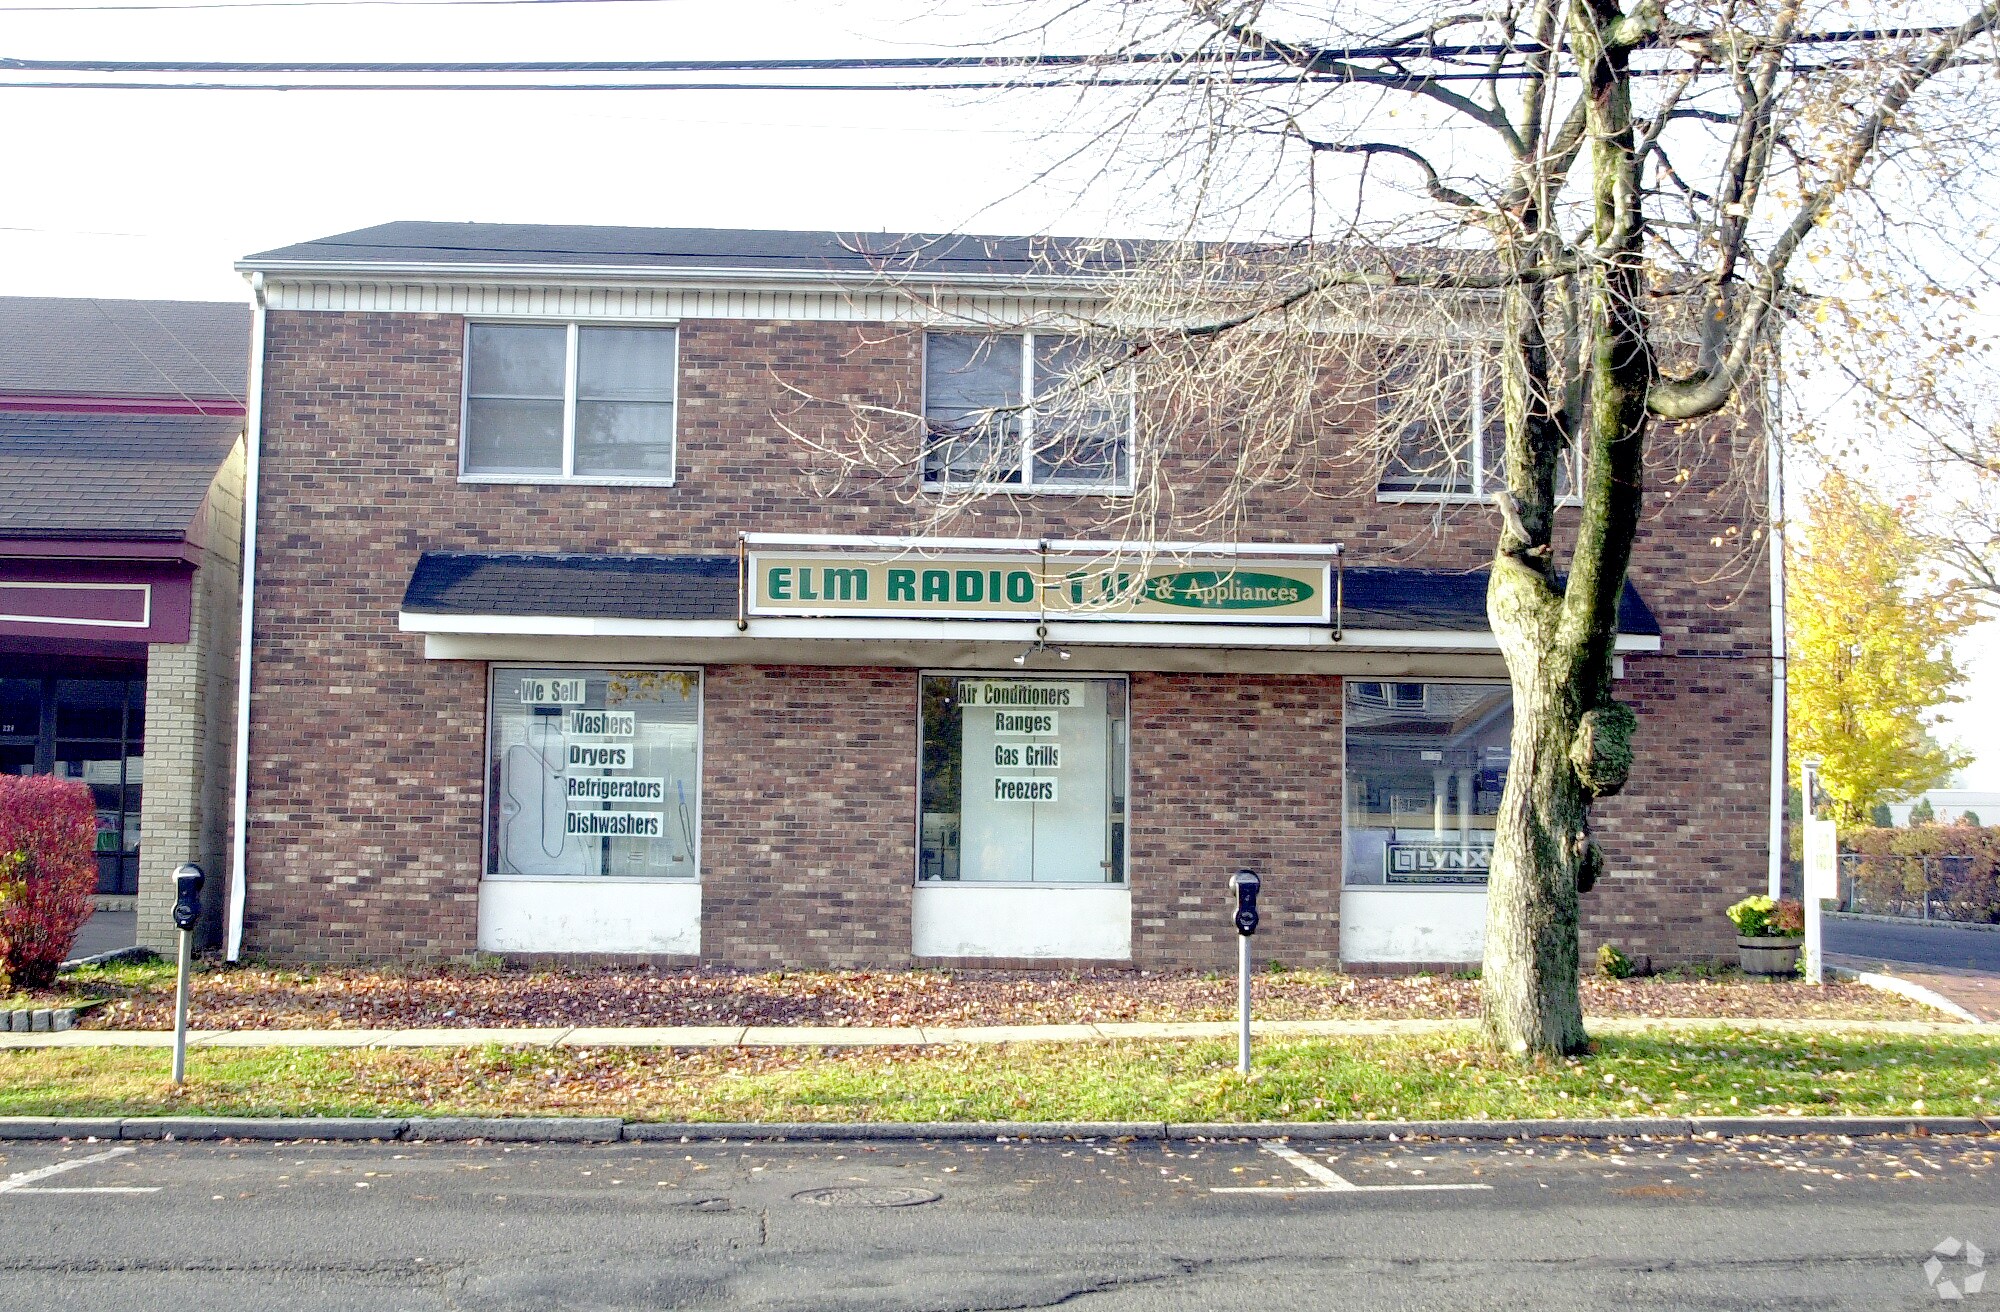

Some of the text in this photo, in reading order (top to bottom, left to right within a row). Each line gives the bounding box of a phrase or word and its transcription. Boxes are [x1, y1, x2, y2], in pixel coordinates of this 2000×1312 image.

[767, 567, 869, 601] ELM
[1155, 576, 1175, 600] &
[1185, 578, 1298, 605] Appliances
[522, 681, 579, 701] We Sell
[958, 684, 1070, 705] Air Conditioners
[570, 712, 633, 734] Washers
[995, 712, 1051, 733] Ranges
[569, 745, 626, 766] Dryers
[995, 745, 1059, 766] Gas Grills
[568, 778, 661, 799] Refrigerators
[995, 778, 1053, 799] Freezers
[567, 812, 658, 834] Dishwashers
[1420, 850, 1489, 868] LYNX
